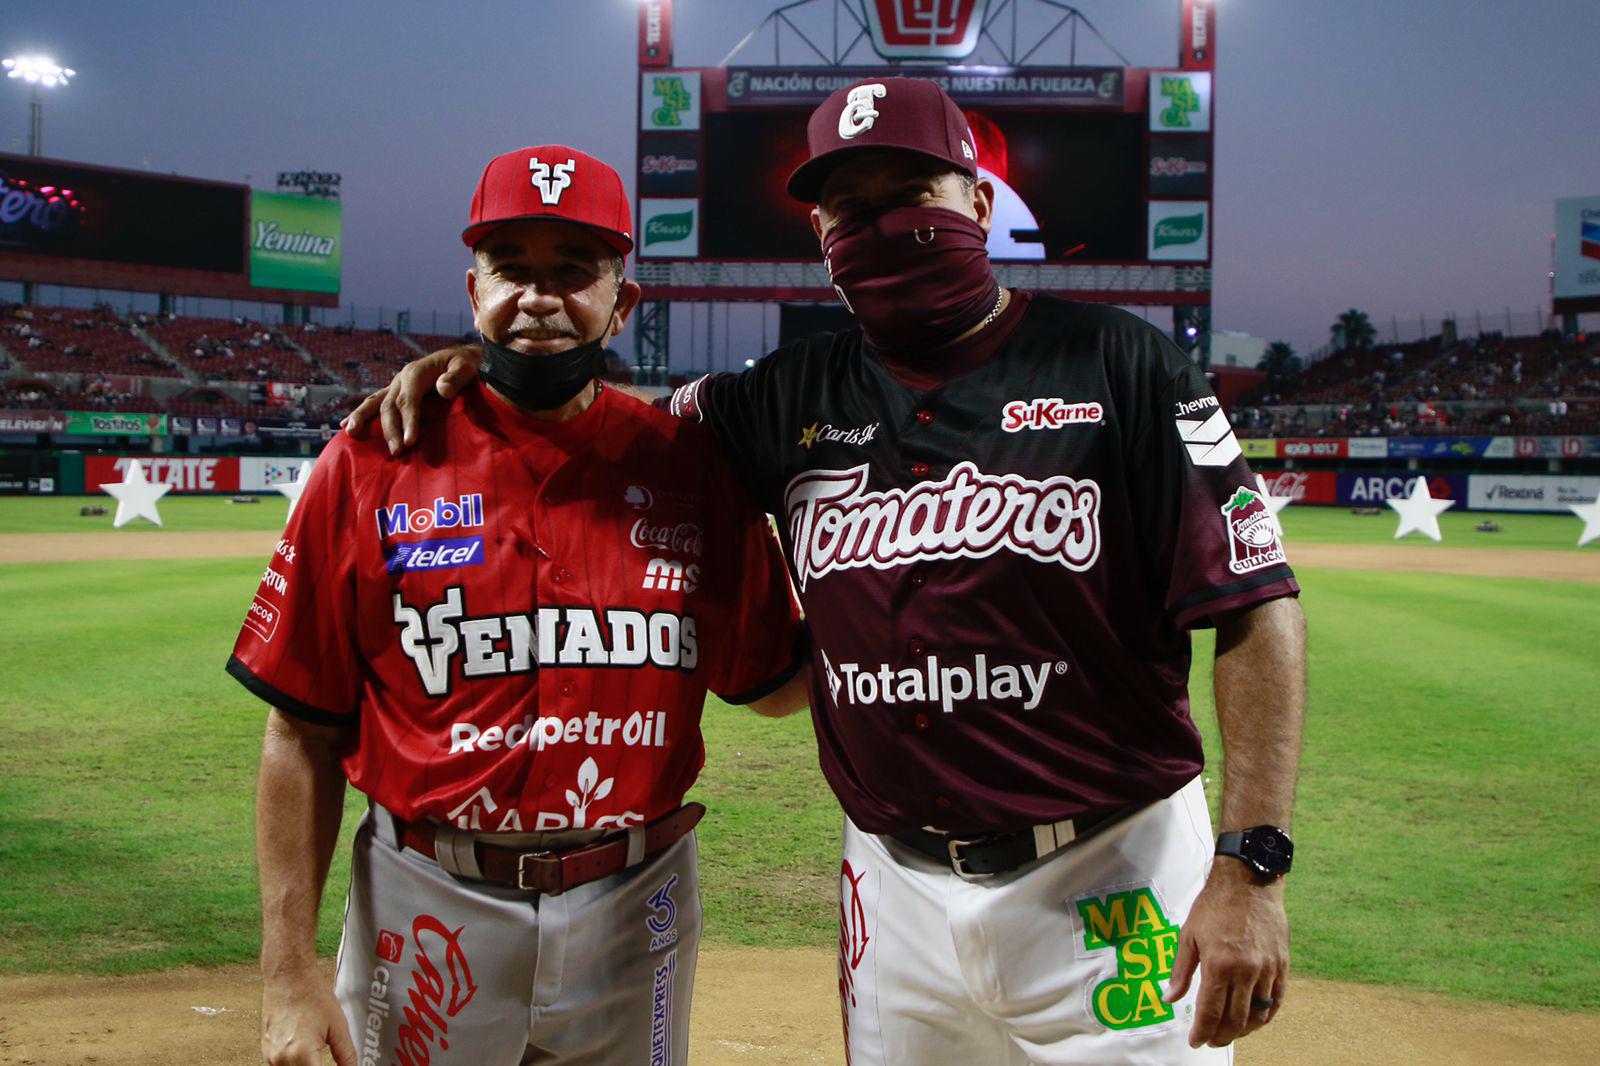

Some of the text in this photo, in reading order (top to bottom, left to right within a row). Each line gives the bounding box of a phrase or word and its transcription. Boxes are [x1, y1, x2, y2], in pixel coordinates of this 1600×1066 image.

[751, 73, 812, 91] NACIÓN
[952, 77, 1028, 92] NUESTRA
[1031, 77, 1095, 92] FUERZA
[255, 220, 335, 256] Yemina
[1002, 399, 1104, 431] SuKarne
[816, 424, 860, 446] Carl's
[375, 493, 484, 540] Mobil
[785, 461, 1101, 593] Tomateros
[406, 541, 480, 568] telcel
[630, 517, 702, 556] Coca-Col
[392, 586, 699, 696] VENADOS
[1086, 894, 1165, 943] MA
[650, 930, 678, 950] AÑOS
[1098, 979, 1168, 1025] CA
